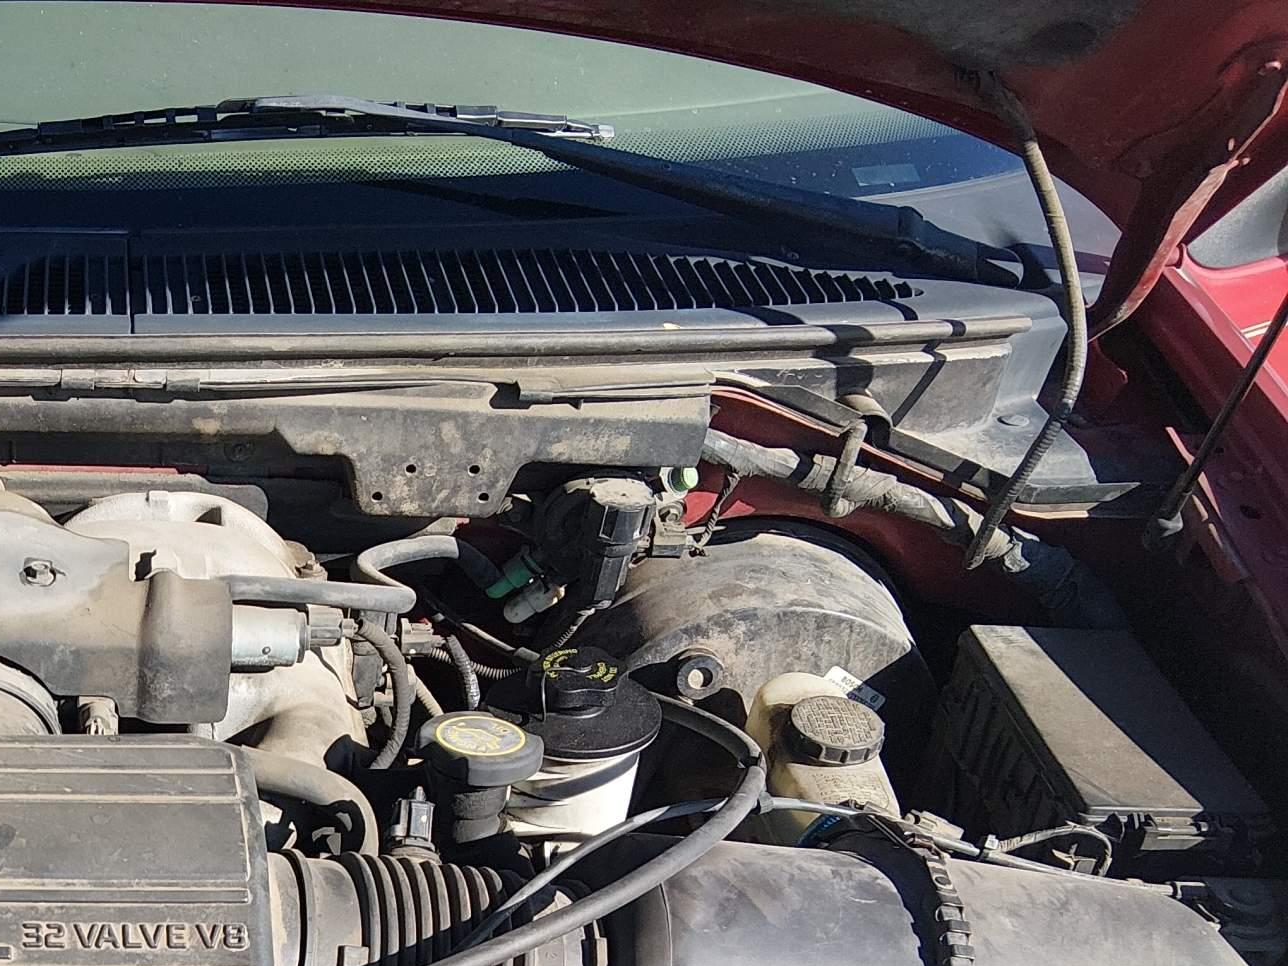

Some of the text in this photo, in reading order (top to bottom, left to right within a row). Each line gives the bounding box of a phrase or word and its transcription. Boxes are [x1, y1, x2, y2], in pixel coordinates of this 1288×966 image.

[21, 922, 65, 949] 32
[72, 922, 187, 950] VALVE
[196, 922, 249, 951] V8
